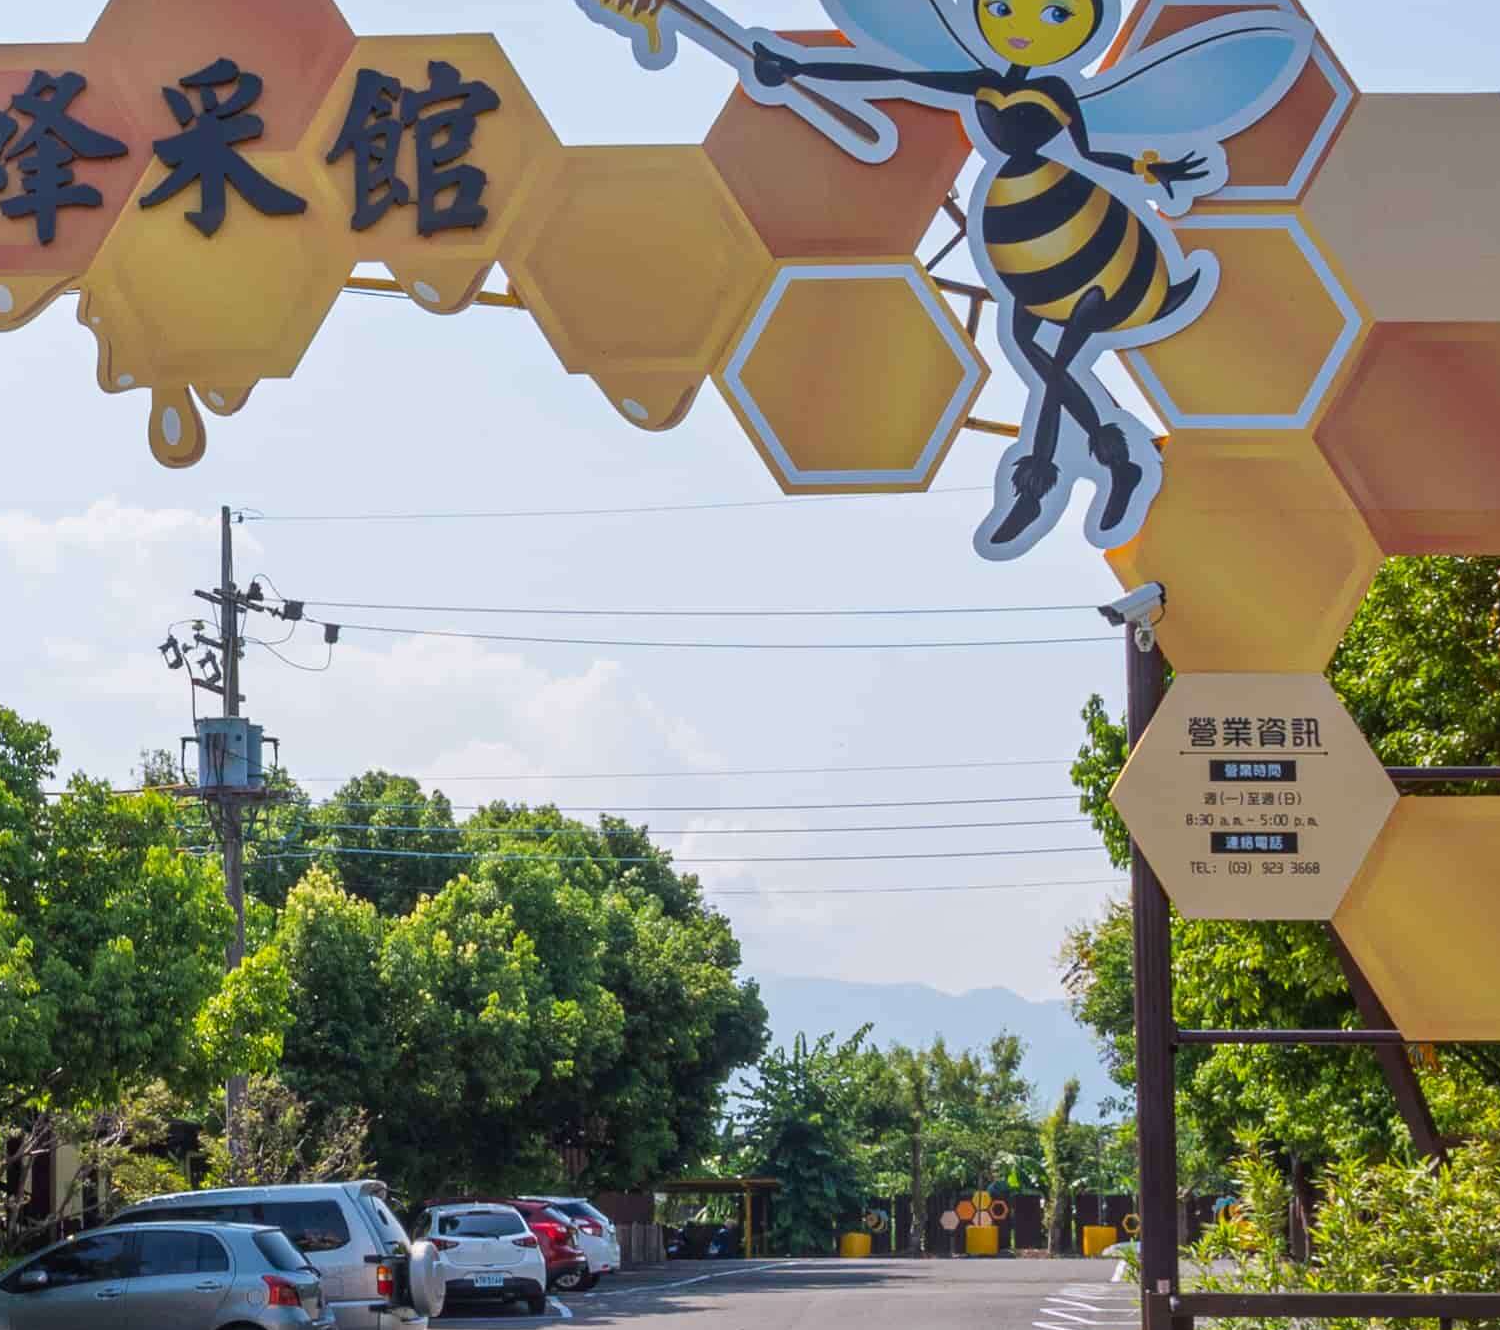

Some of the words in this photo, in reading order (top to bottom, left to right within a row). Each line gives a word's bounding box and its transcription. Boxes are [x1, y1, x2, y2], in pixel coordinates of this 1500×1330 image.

[1187, 715, 1323, 748] 營業資訊
[1185, 813, 1214, 827] 8:30
[1259, 813, 1289, 827] 5:00
[1228, 860, 1252, 875] (03)
[1261, 860, 1284, 875] 923
